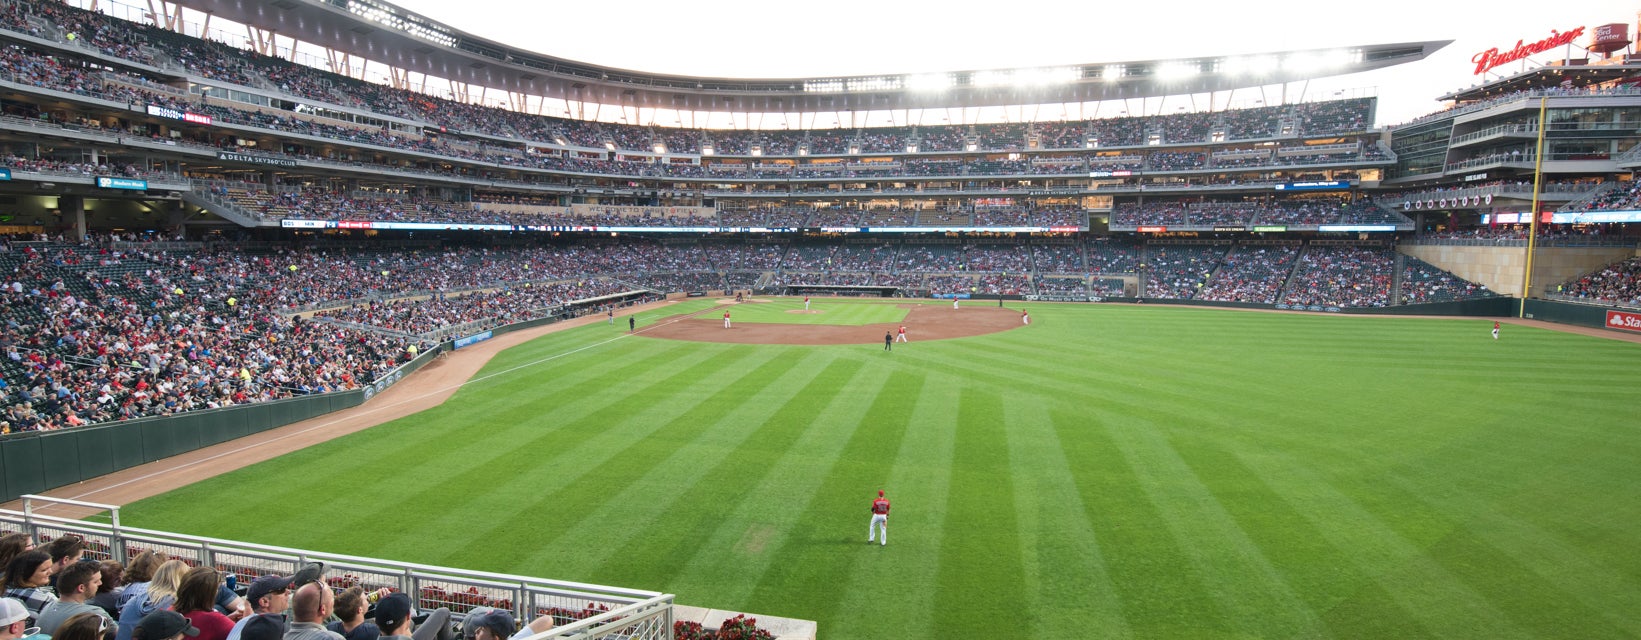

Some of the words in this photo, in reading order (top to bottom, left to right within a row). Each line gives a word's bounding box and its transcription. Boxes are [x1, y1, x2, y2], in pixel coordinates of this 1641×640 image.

[1471, 26, 1586, 75] Budweiser
[228, 153, 253, 163] DELTA
[1624, 315, 1641, 328] Sta
